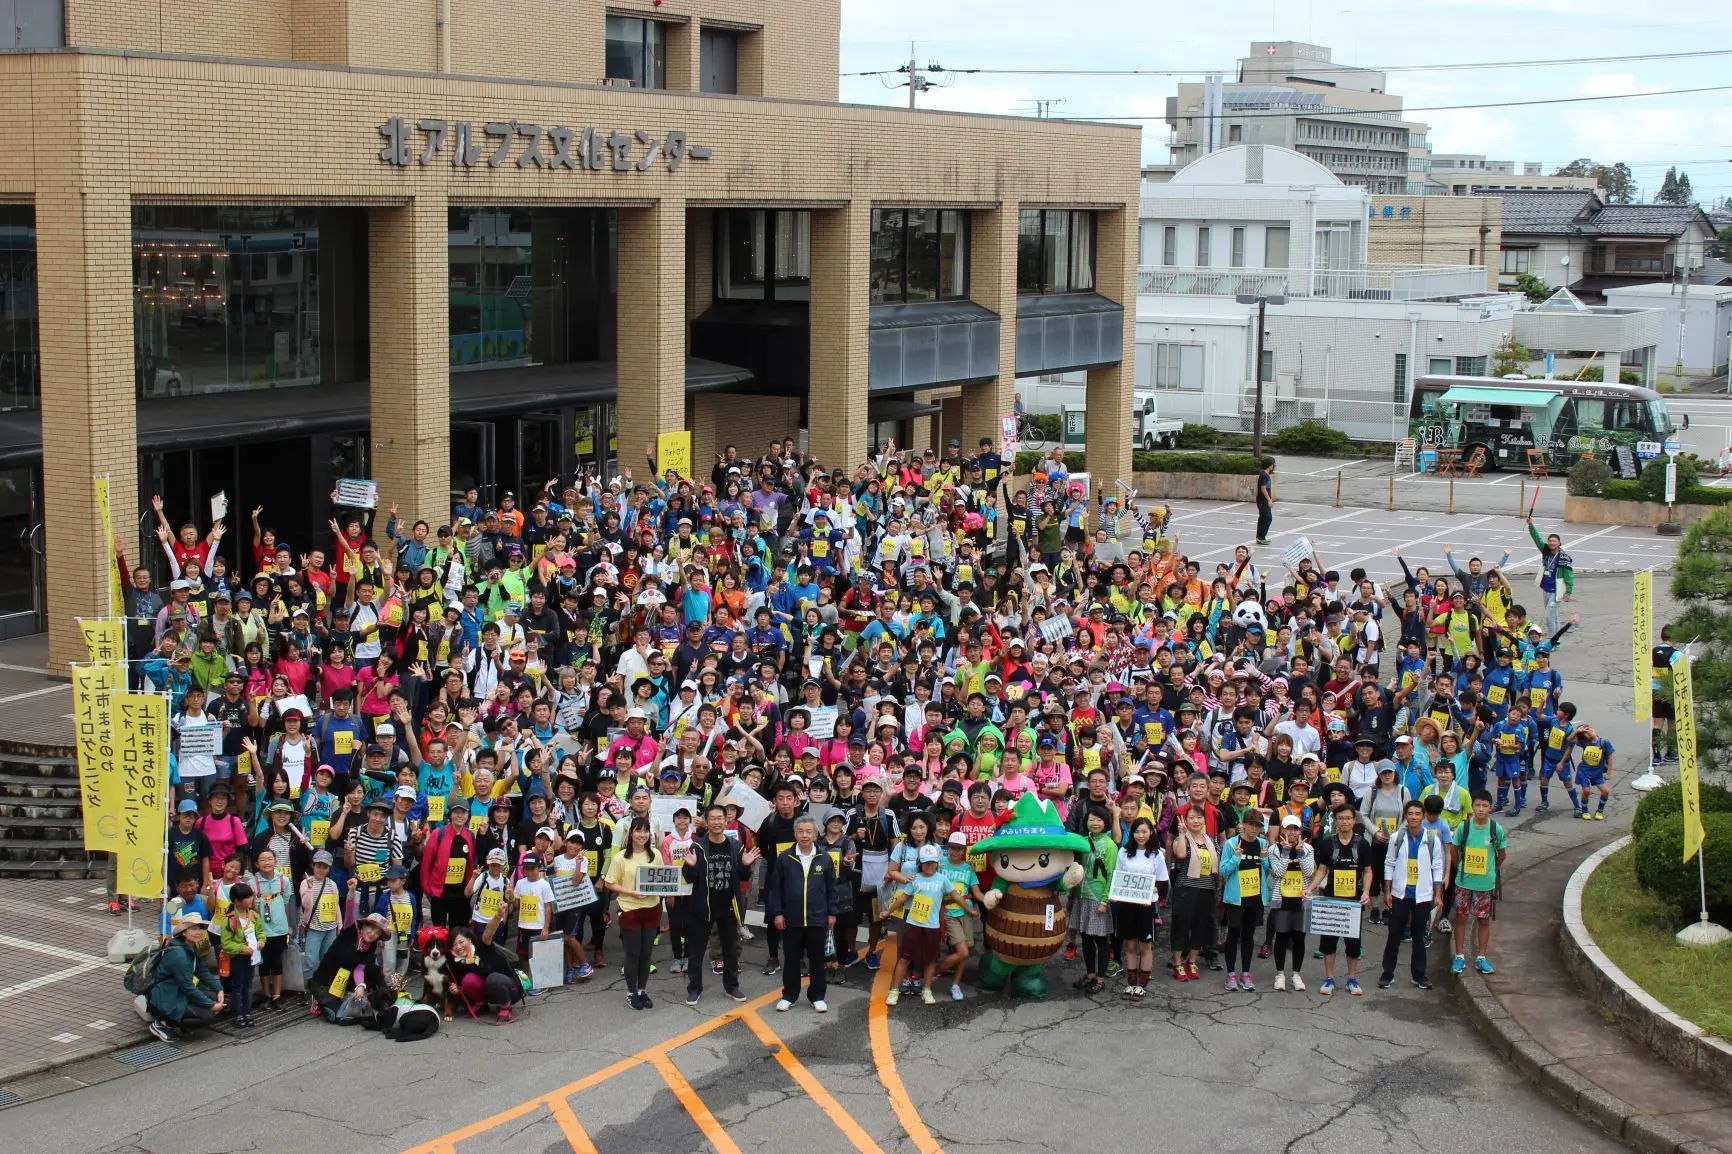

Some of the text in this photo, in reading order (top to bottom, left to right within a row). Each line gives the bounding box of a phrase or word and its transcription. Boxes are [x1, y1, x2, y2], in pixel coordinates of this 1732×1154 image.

[379, 115, 712, 172] 北アルプス文化センター
[1000, 827, 1047, 836] かみいちまち
[1467, 855, 1485, 863] 3101
[447, 865, 464, 873] 3235
[360, 870, 379, 879] 3135
[647, 868, 672, 883] 9:50
[1241, 876, 1259, 885] 3219
[1283, 877, 1301, 885] 3219
[1336, 877, 1355, 885] 3219
[521, 902, 537, 911] 3102
